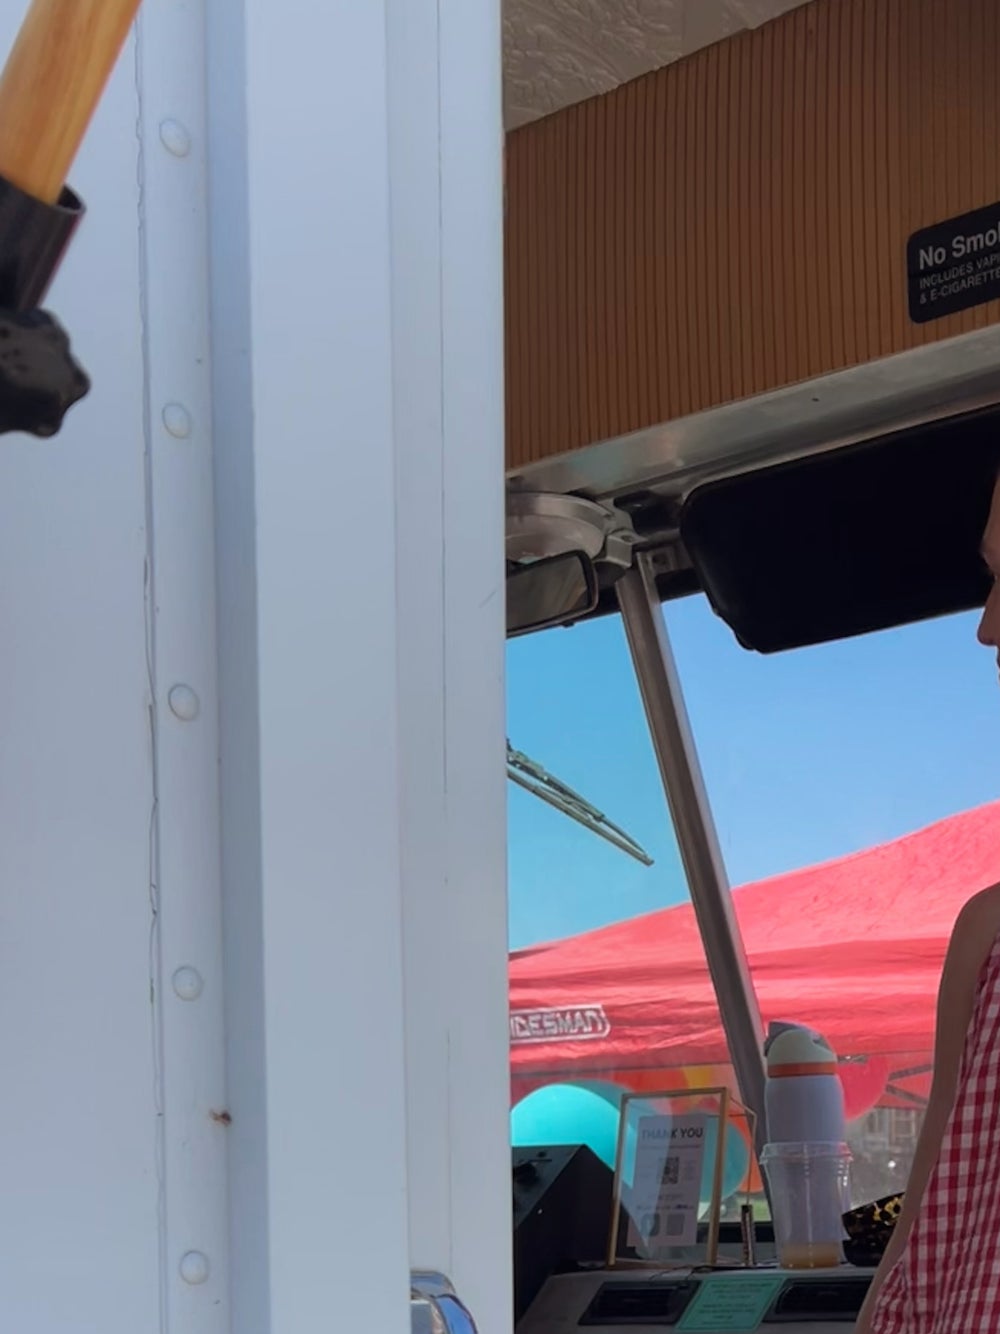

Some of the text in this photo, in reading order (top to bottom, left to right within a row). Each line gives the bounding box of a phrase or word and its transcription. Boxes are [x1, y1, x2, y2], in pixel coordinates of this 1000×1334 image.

[918, 245, 946, 270] No
[919, 261, 974, 289] INCLUDES
[919, 292, 927, 304] &
[642, 1126, 704, 1139] THANK YOU
